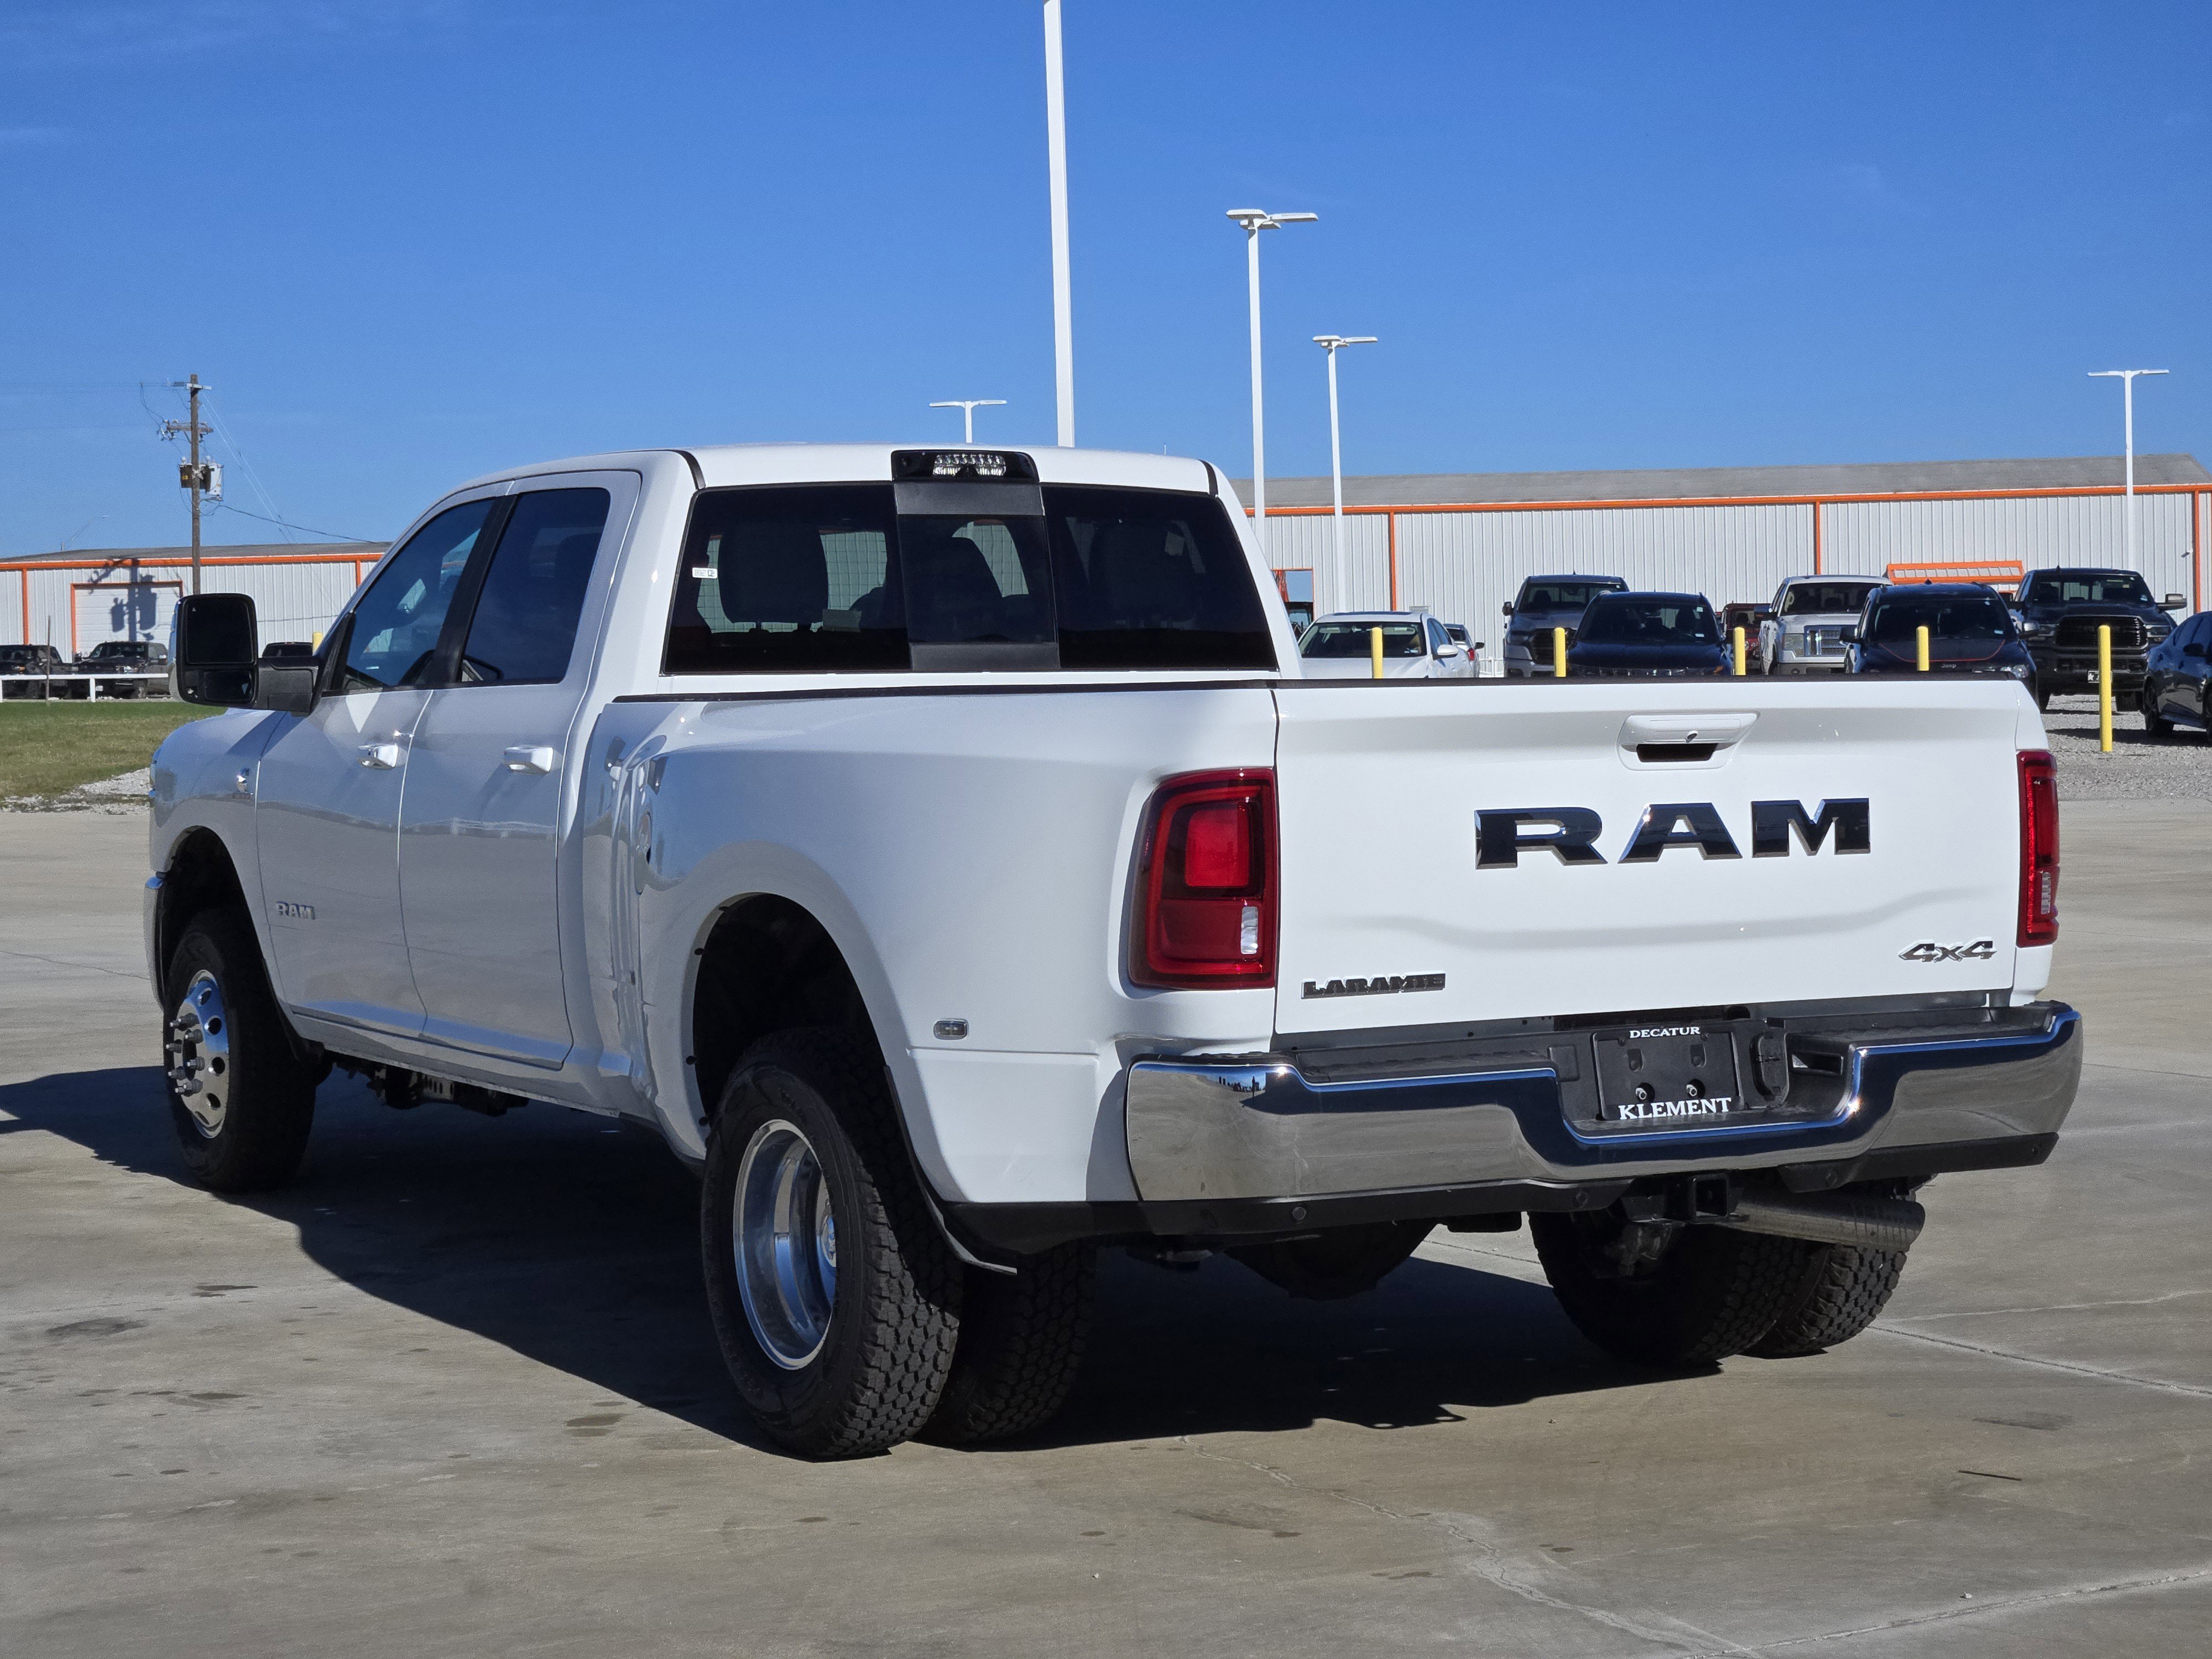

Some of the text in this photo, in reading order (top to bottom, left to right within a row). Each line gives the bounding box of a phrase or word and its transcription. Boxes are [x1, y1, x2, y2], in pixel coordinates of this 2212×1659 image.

[1474, 798, 1871, 869] RAM
[275, 901, 315, 920] RAM
[1898, 938, 1997, 962] 4x4
[1301, 973, 1446, 999] LARAMIE
[1630, 1026, 1700, 1039] DECATUR
[1618, 1097, 1731, 1120] KLEMENT
